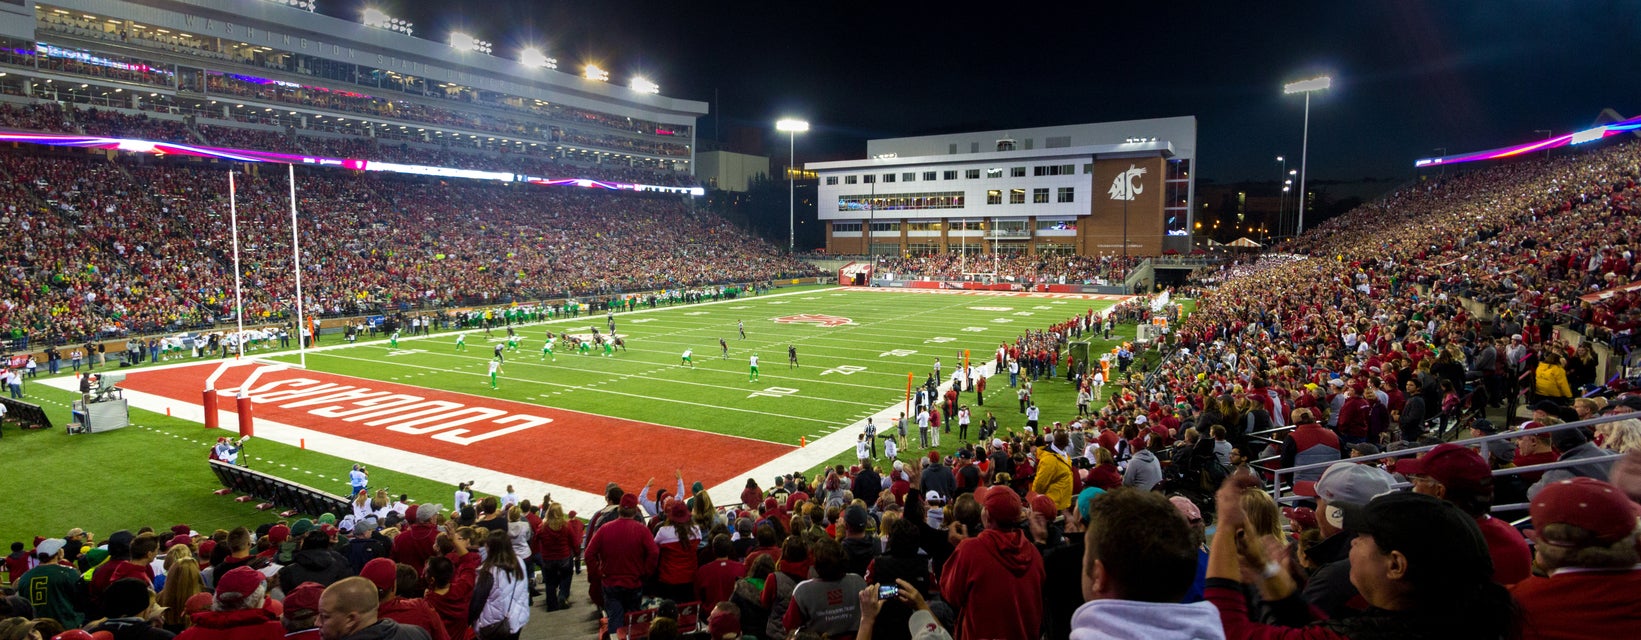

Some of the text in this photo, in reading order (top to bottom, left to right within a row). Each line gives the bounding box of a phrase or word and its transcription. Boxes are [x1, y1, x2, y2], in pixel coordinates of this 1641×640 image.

[186, 15, 355, 58] WASHINGTON
[377, 55, 429, 73] STATE
[217, 377, 554, 446] COUGARS
[30, 576, 49, 606] 6
